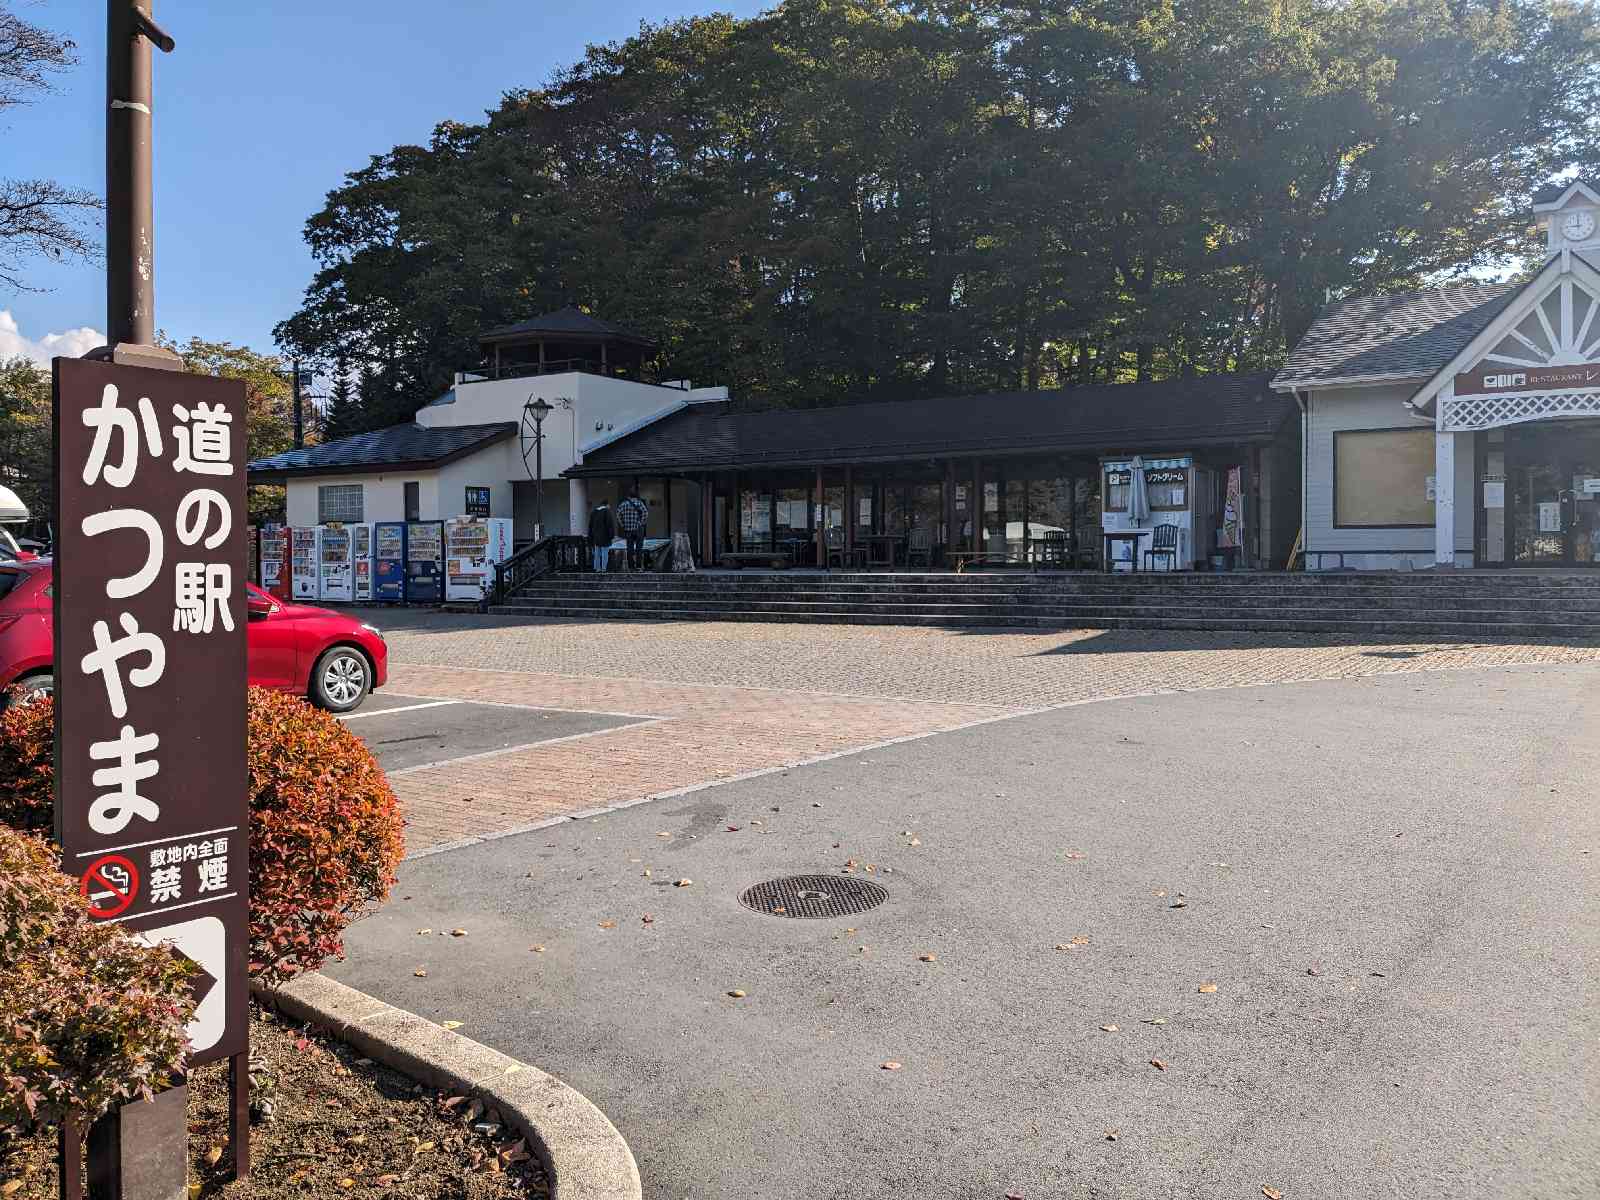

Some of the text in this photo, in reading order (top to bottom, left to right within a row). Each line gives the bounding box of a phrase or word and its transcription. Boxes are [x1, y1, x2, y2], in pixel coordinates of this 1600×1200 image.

[1530, 373, 1584, 384] RESTAURANT
[172, 401, 235, 634] 道の駅
[81, 383, 166, 835] かつやま
[150, 837, 229, 868] 敷地内全面
